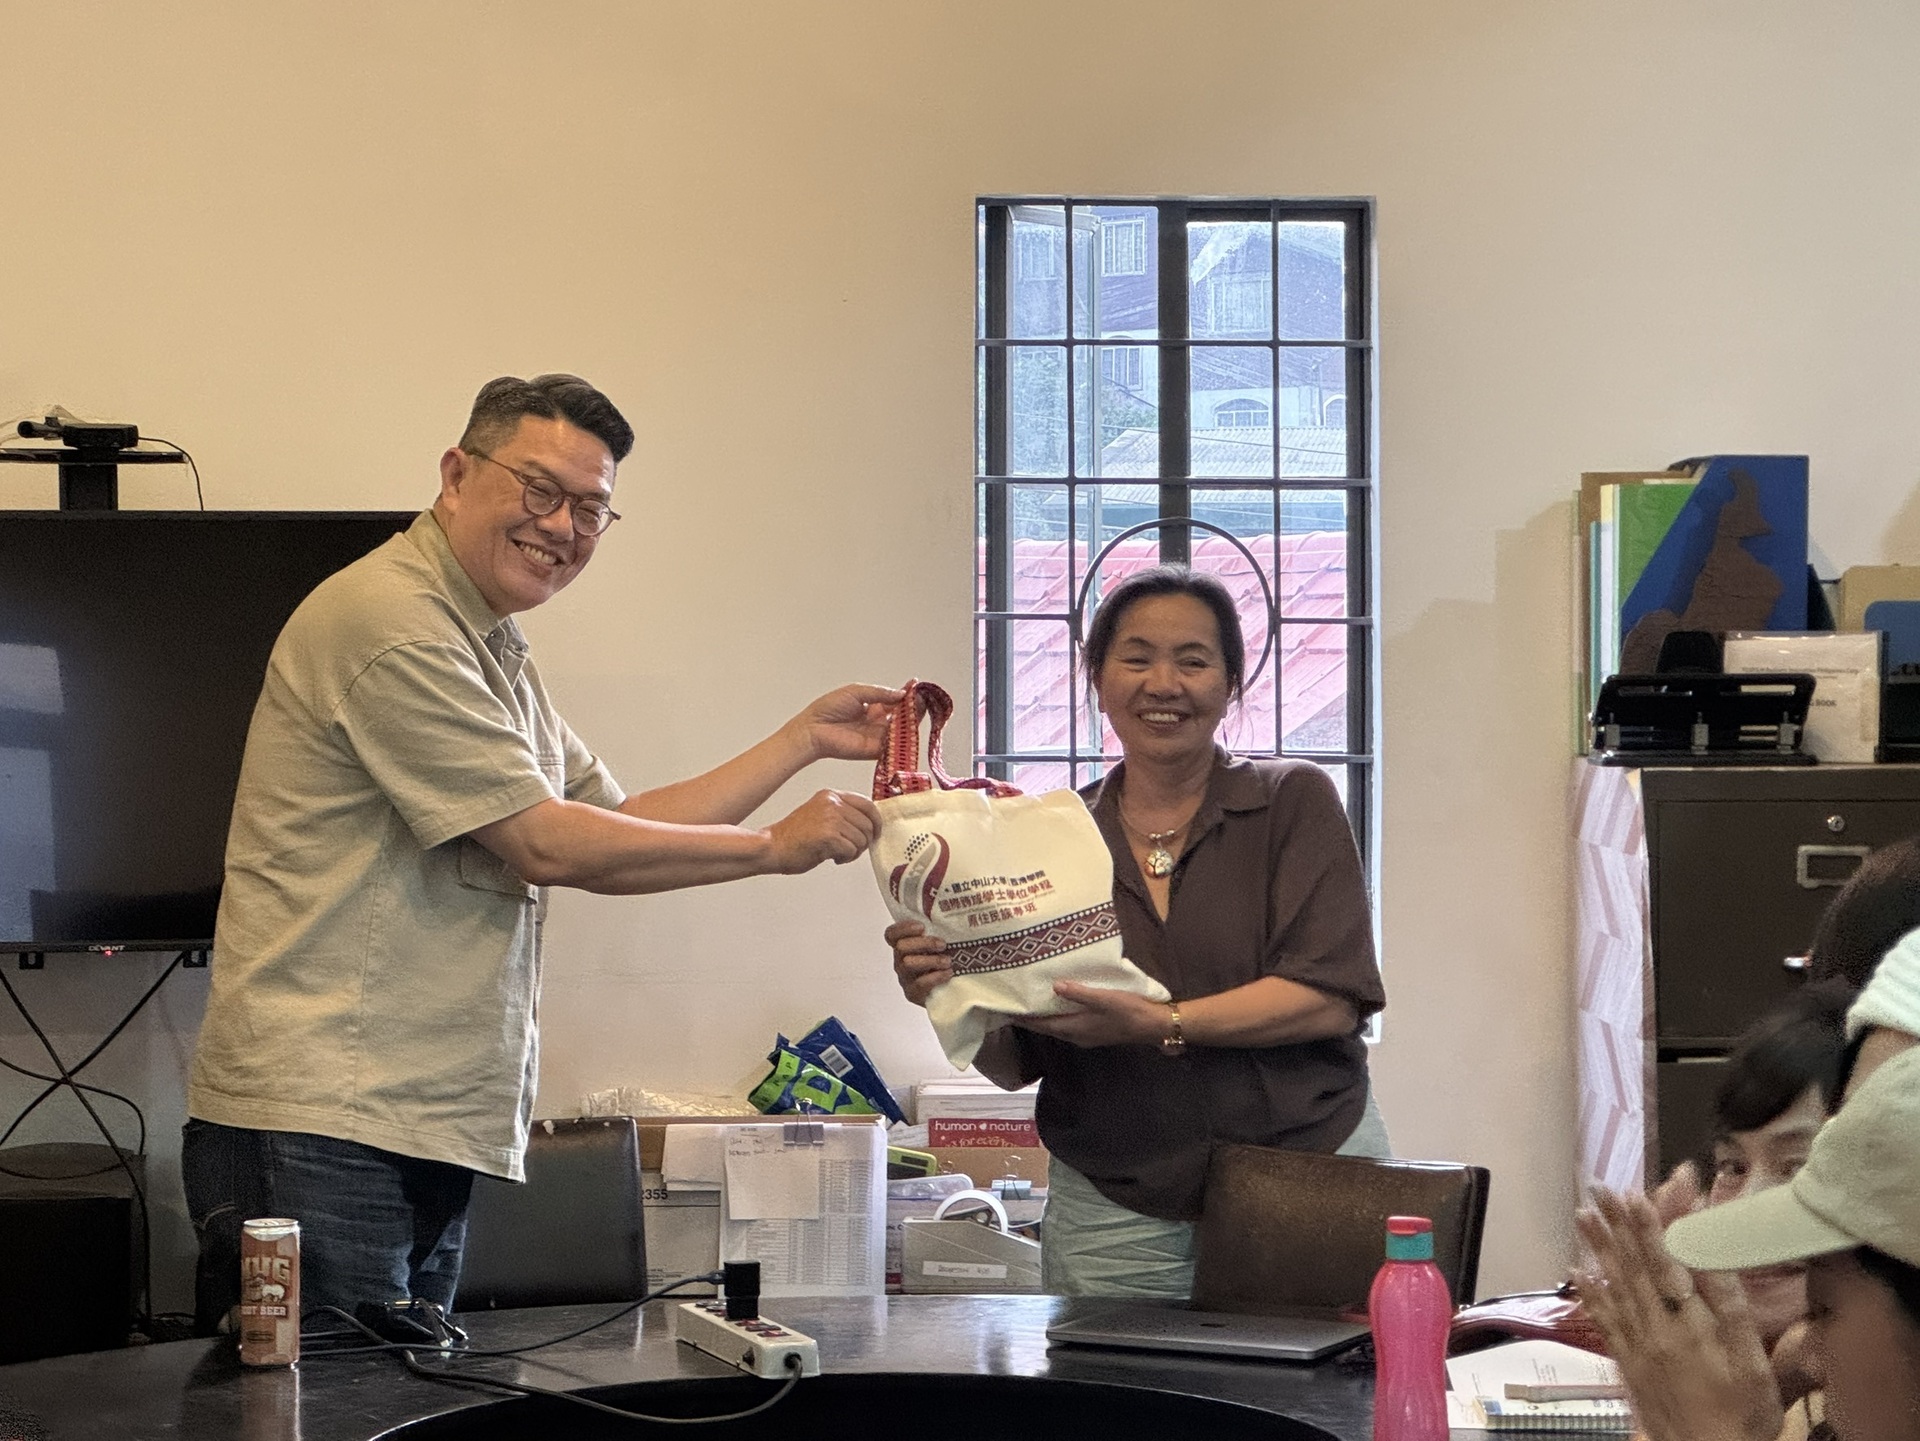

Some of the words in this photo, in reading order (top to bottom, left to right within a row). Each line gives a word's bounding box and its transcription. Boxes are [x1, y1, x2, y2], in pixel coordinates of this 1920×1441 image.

[935, 1120, 977, 1131] human
[989, 1122, 1031, 1132] nature
[642, 1188, 668, 1200] 355
[260, 1305, 287, 1316] BEER
